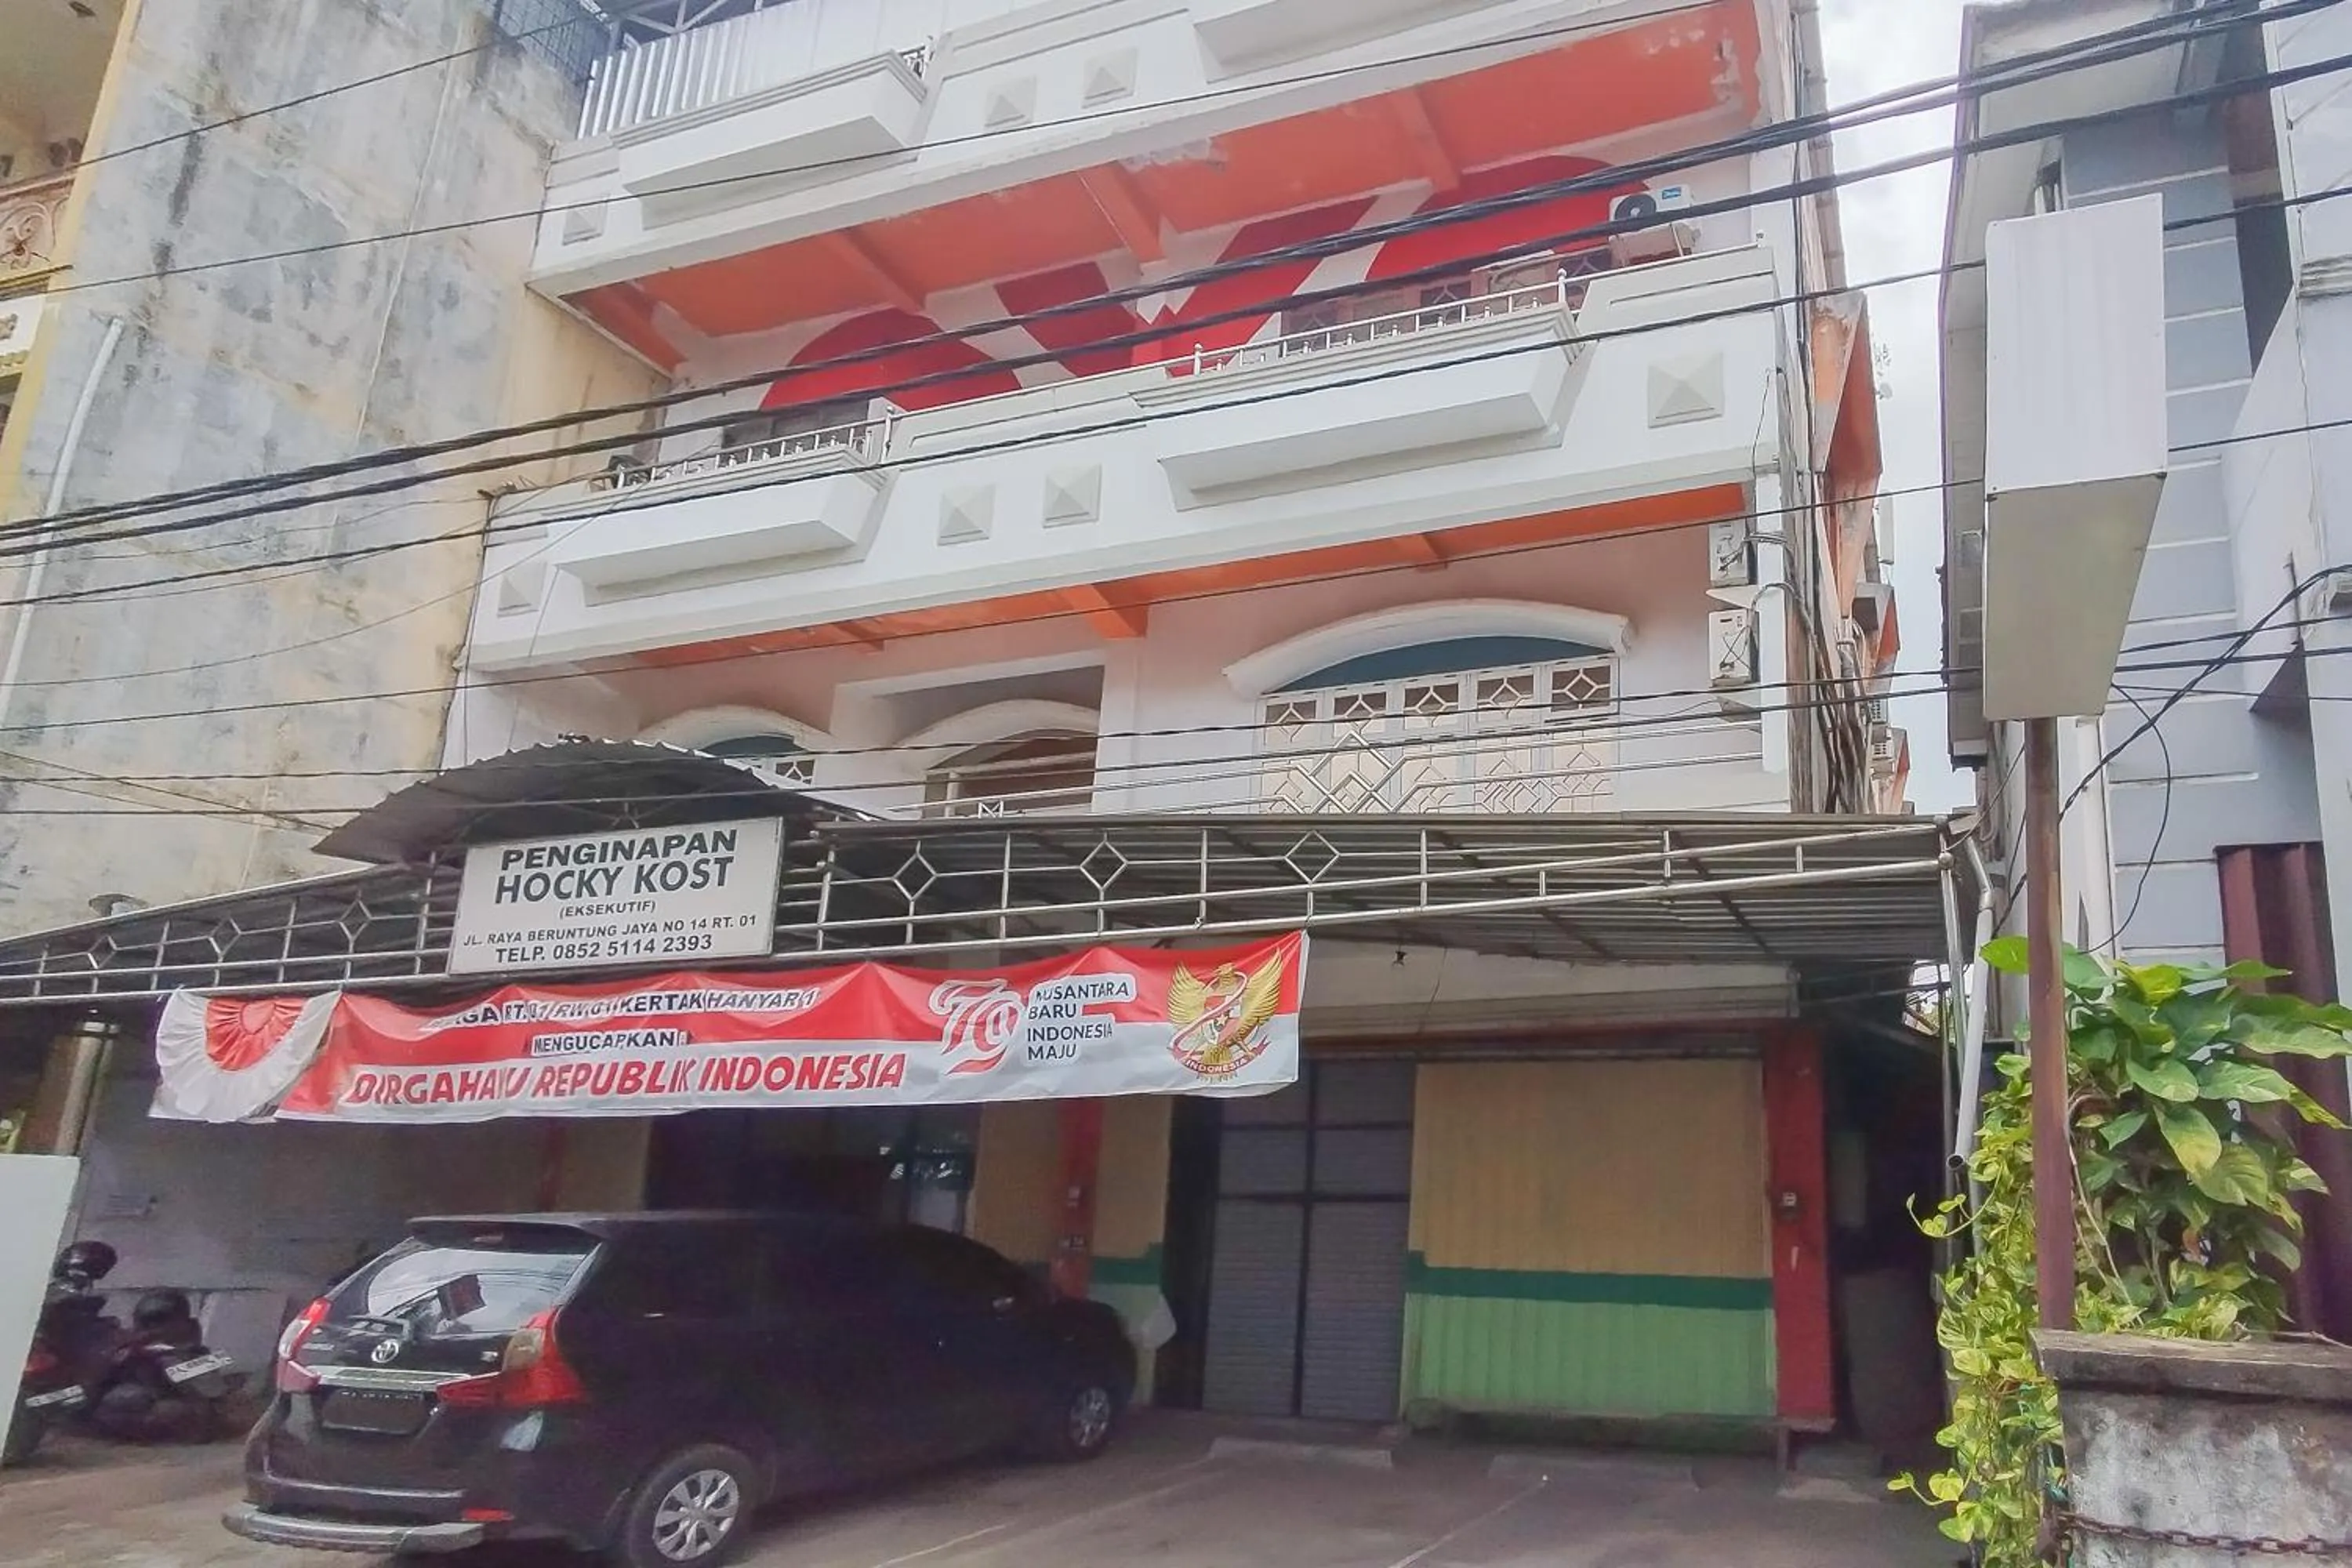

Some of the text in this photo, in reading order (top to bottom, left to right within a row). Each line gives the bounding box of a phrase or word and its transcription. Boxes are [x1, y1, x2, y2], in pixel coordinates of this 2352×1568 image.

[501, 829, 737, 871] PENGINAPAN
[495, 855, 735, 904] HOCKY KOST
[559, 901, 656, 919] (EKSEKUTIF)
[463, 935, 482, 946] JL.
[487, 931, 521, 944] RAYA
[528, 925, 617, 942] BERUNTUNG
[622, 923, 658, 935] JAYA
[662, 920, 684, 932] NO
[690, 918, 707, 931] 14
[739, 915, 756, 927] 01
[495, 935, 712, 964] TELP. 0852 5114 2393
[1036, 982, 1129, 1001] NUSANTARA
[619, 993, 702, 1012] KERTAK
[707, 992, 799, 1009] HANYAR
[1029, 1004, 1076, 1020] BARU
[1028, 1023, 1112, 1042] INDONESIA
[1028, 1044, 1076, 1060] MAJU
[1185, 1058, 1247, 1073] INDONESIA
[532, 1058, 696, 1098] REPUBLIK
[699, 1054, 906, 1092] INDONESIA
